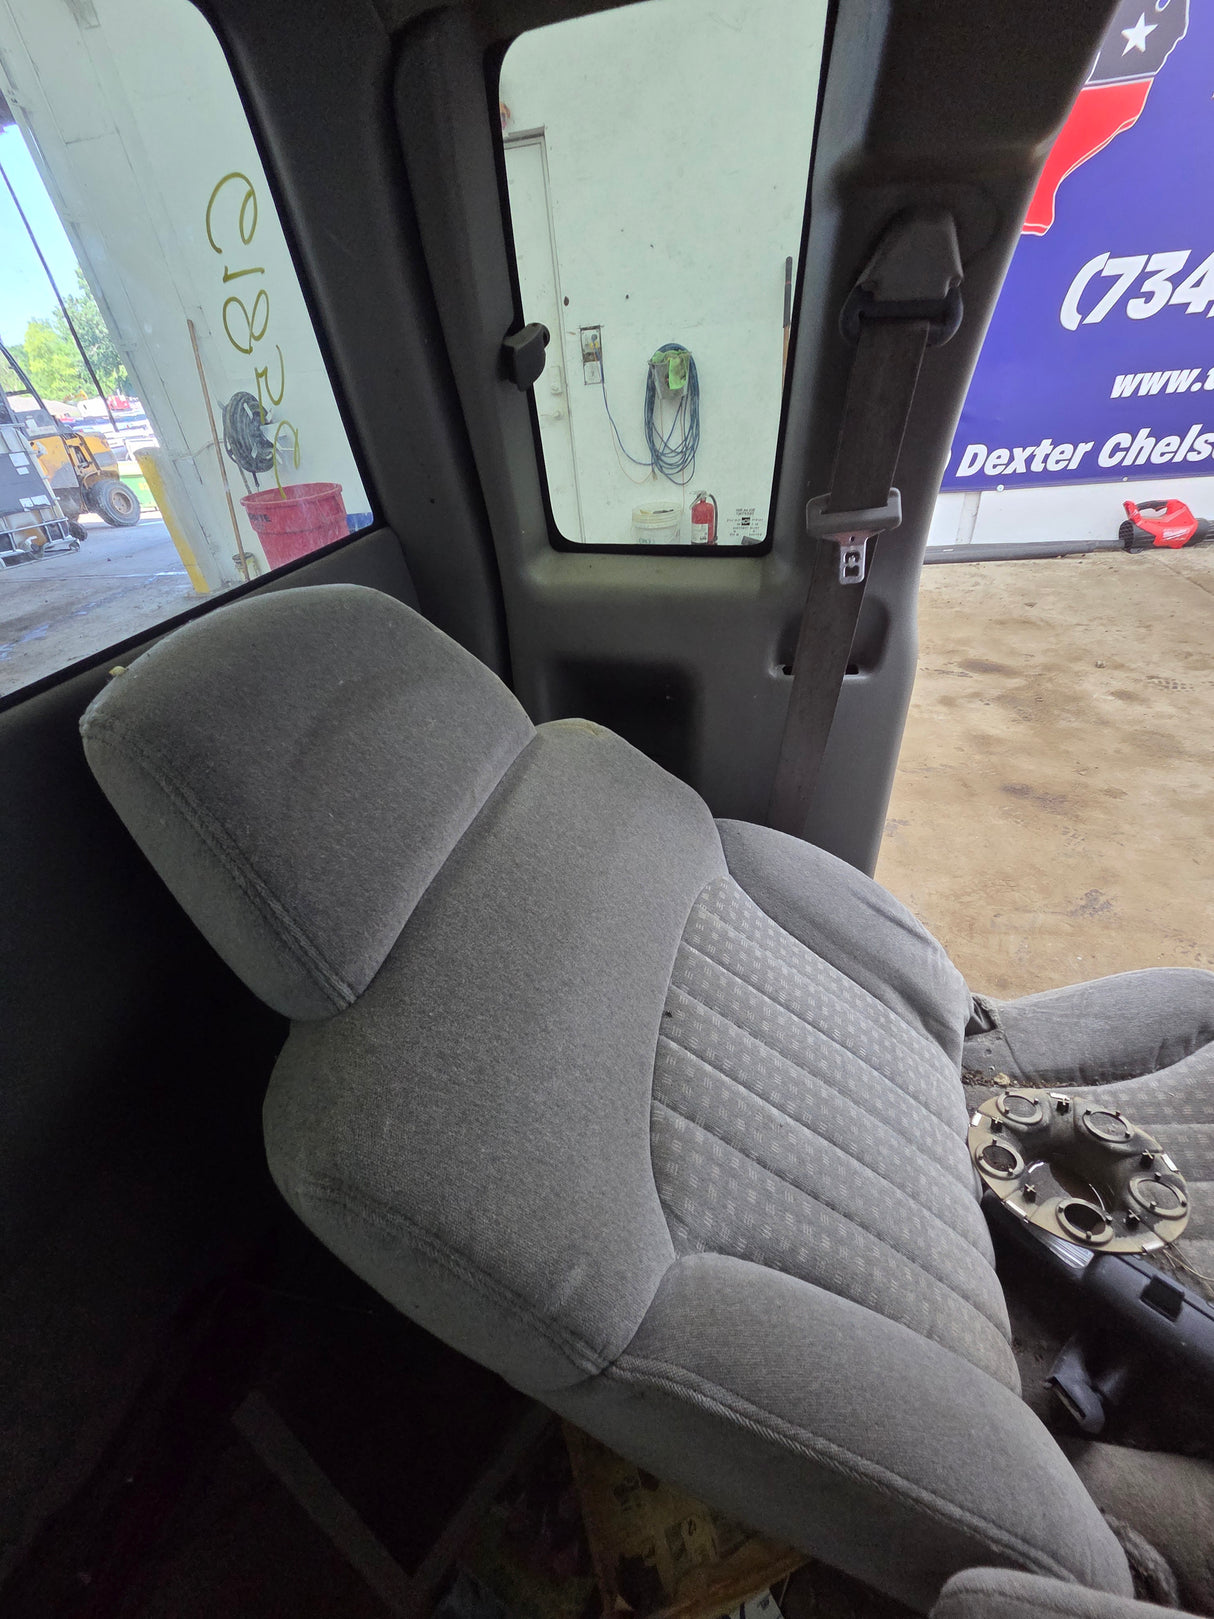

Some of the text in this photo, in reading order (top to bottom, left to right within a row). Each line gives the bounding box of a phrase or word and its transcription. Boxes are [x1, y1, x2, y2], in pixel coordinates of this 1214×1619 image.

[1059, 249, 1214, 331] (734
[955, 423, 1214, 478] Dexter Chels
